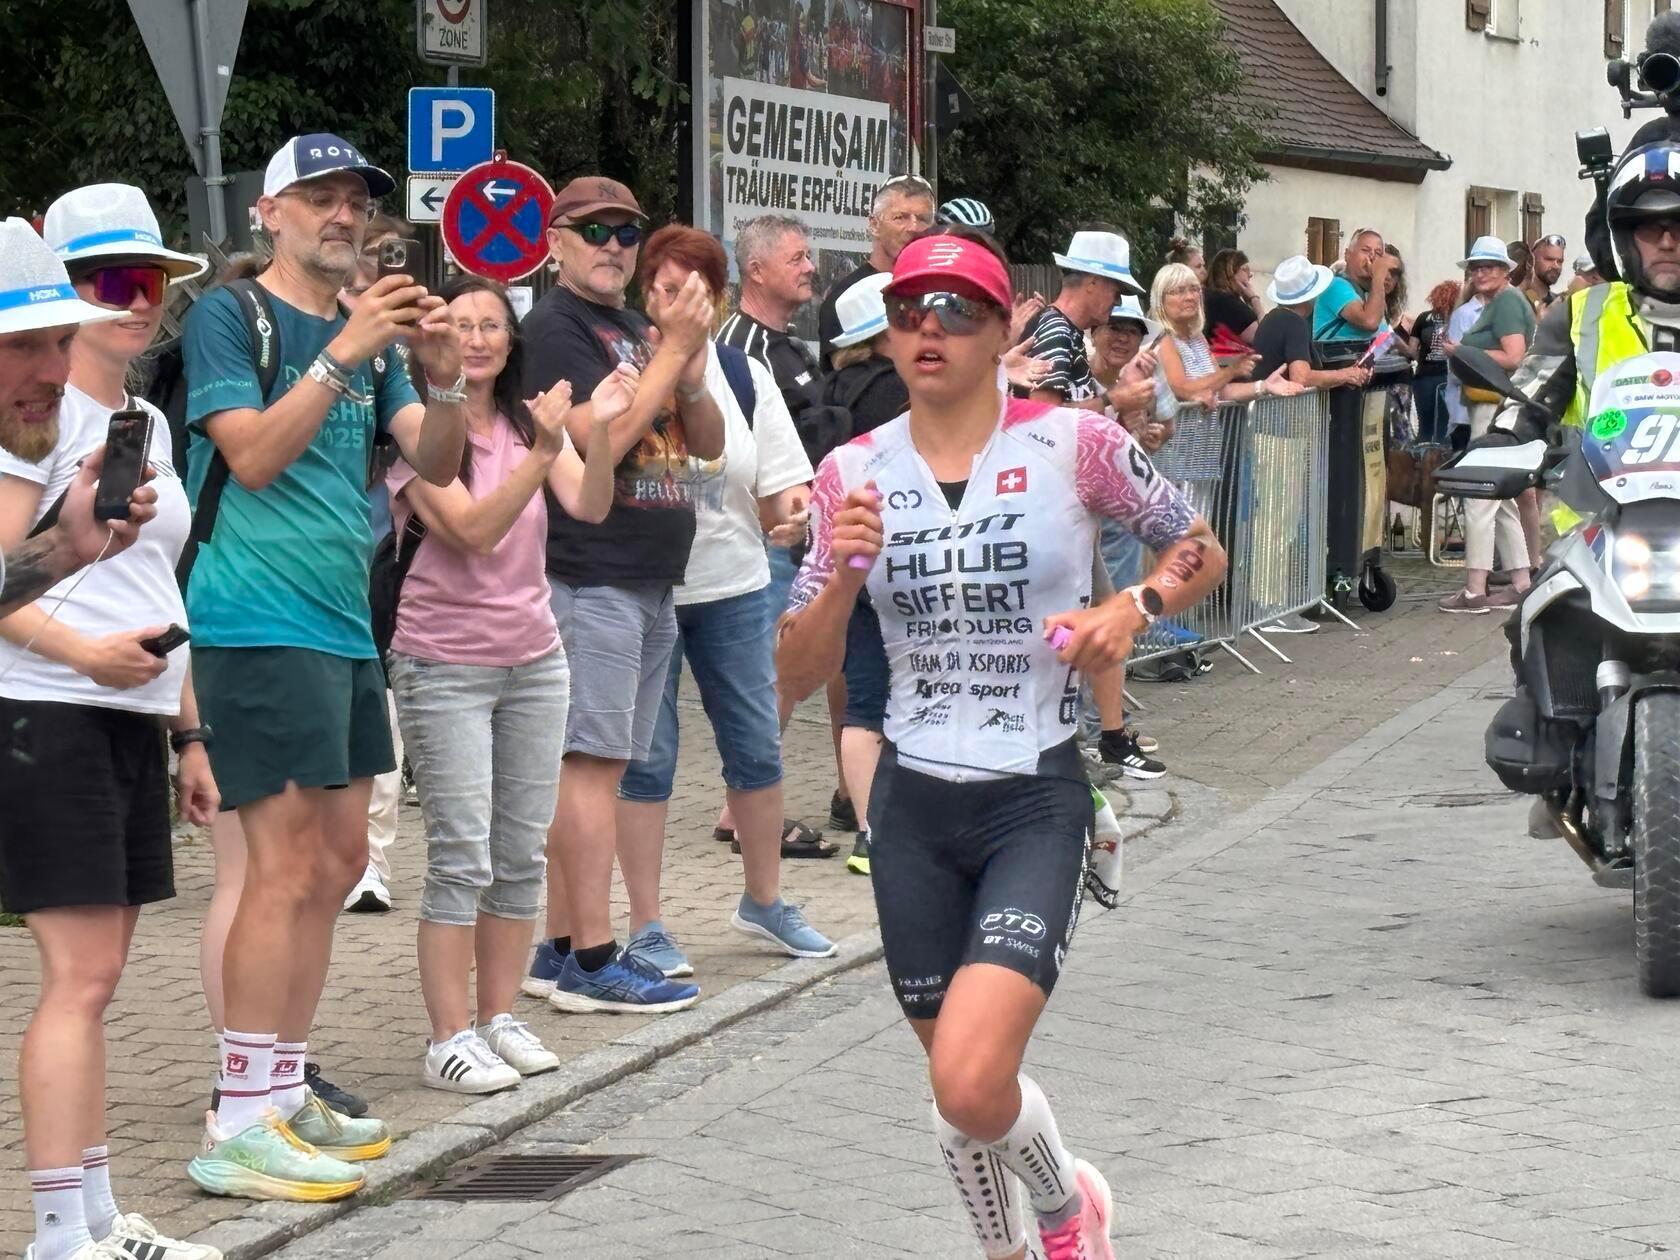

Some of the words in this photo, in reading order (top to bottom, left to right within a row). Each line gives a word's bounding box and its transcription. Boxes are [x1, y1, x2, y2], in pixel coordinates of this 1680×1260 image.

[439, 28, 468, 50] ZONE
[432, 100, 475, 161] P
[727, 95, 888, 173] GEMEINSAM
[726, 159, 798, 210] TRÄUME
[29, 288, 61, 301] HOKA
[887, 513, 1025, 547] SCOTT
[886, 541, 1028, 583] HUUB
[892, 579, 1029, 616] SIFFERT
[909, 653, 942, 673] TEAM
[968, 682, 1021, 702] sport
[983, 913, 1043, 935] PTO
[1005, 937, 1040, 958] SWISS
